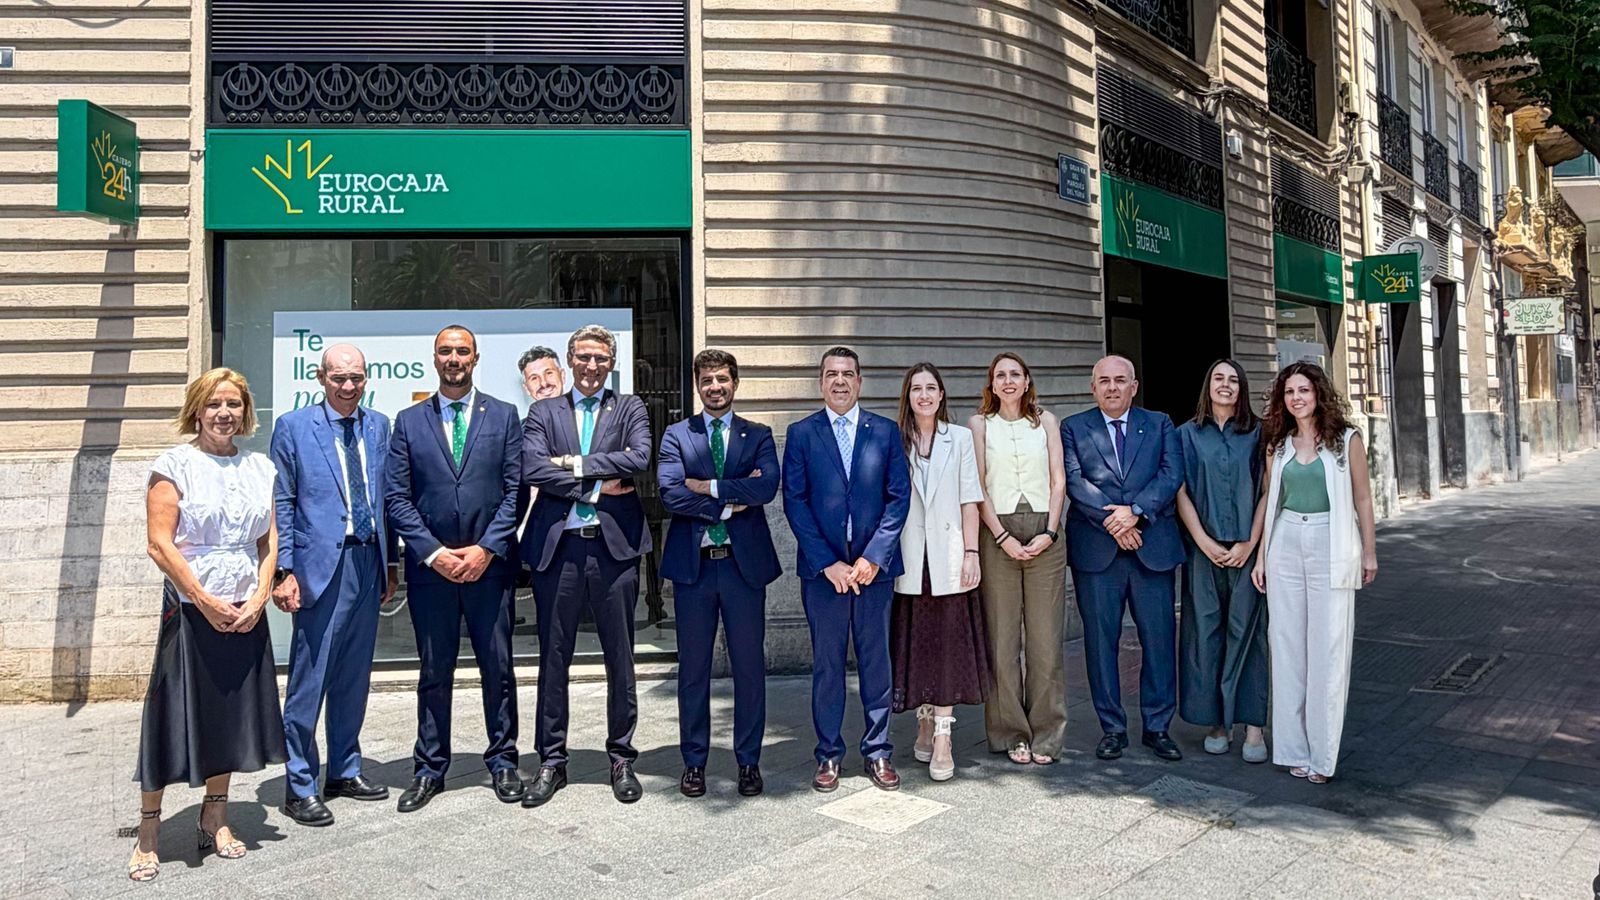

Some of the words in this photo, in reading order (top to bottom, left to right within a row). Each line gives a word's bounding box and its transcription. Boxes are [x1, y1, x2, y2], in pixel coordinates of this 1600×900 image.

[104, 161, 132, 200] 24h
[318, 173, 450, 193] EUROCAJA
[318, 195, 405, 214] RURAL
[1135, 218, 1171, 242] EUROCAJA
[1136, 234, 1160, 254] RURAL
[1384, 275, 1414, 293] 24h
[293, 329, 323, 351] Te
